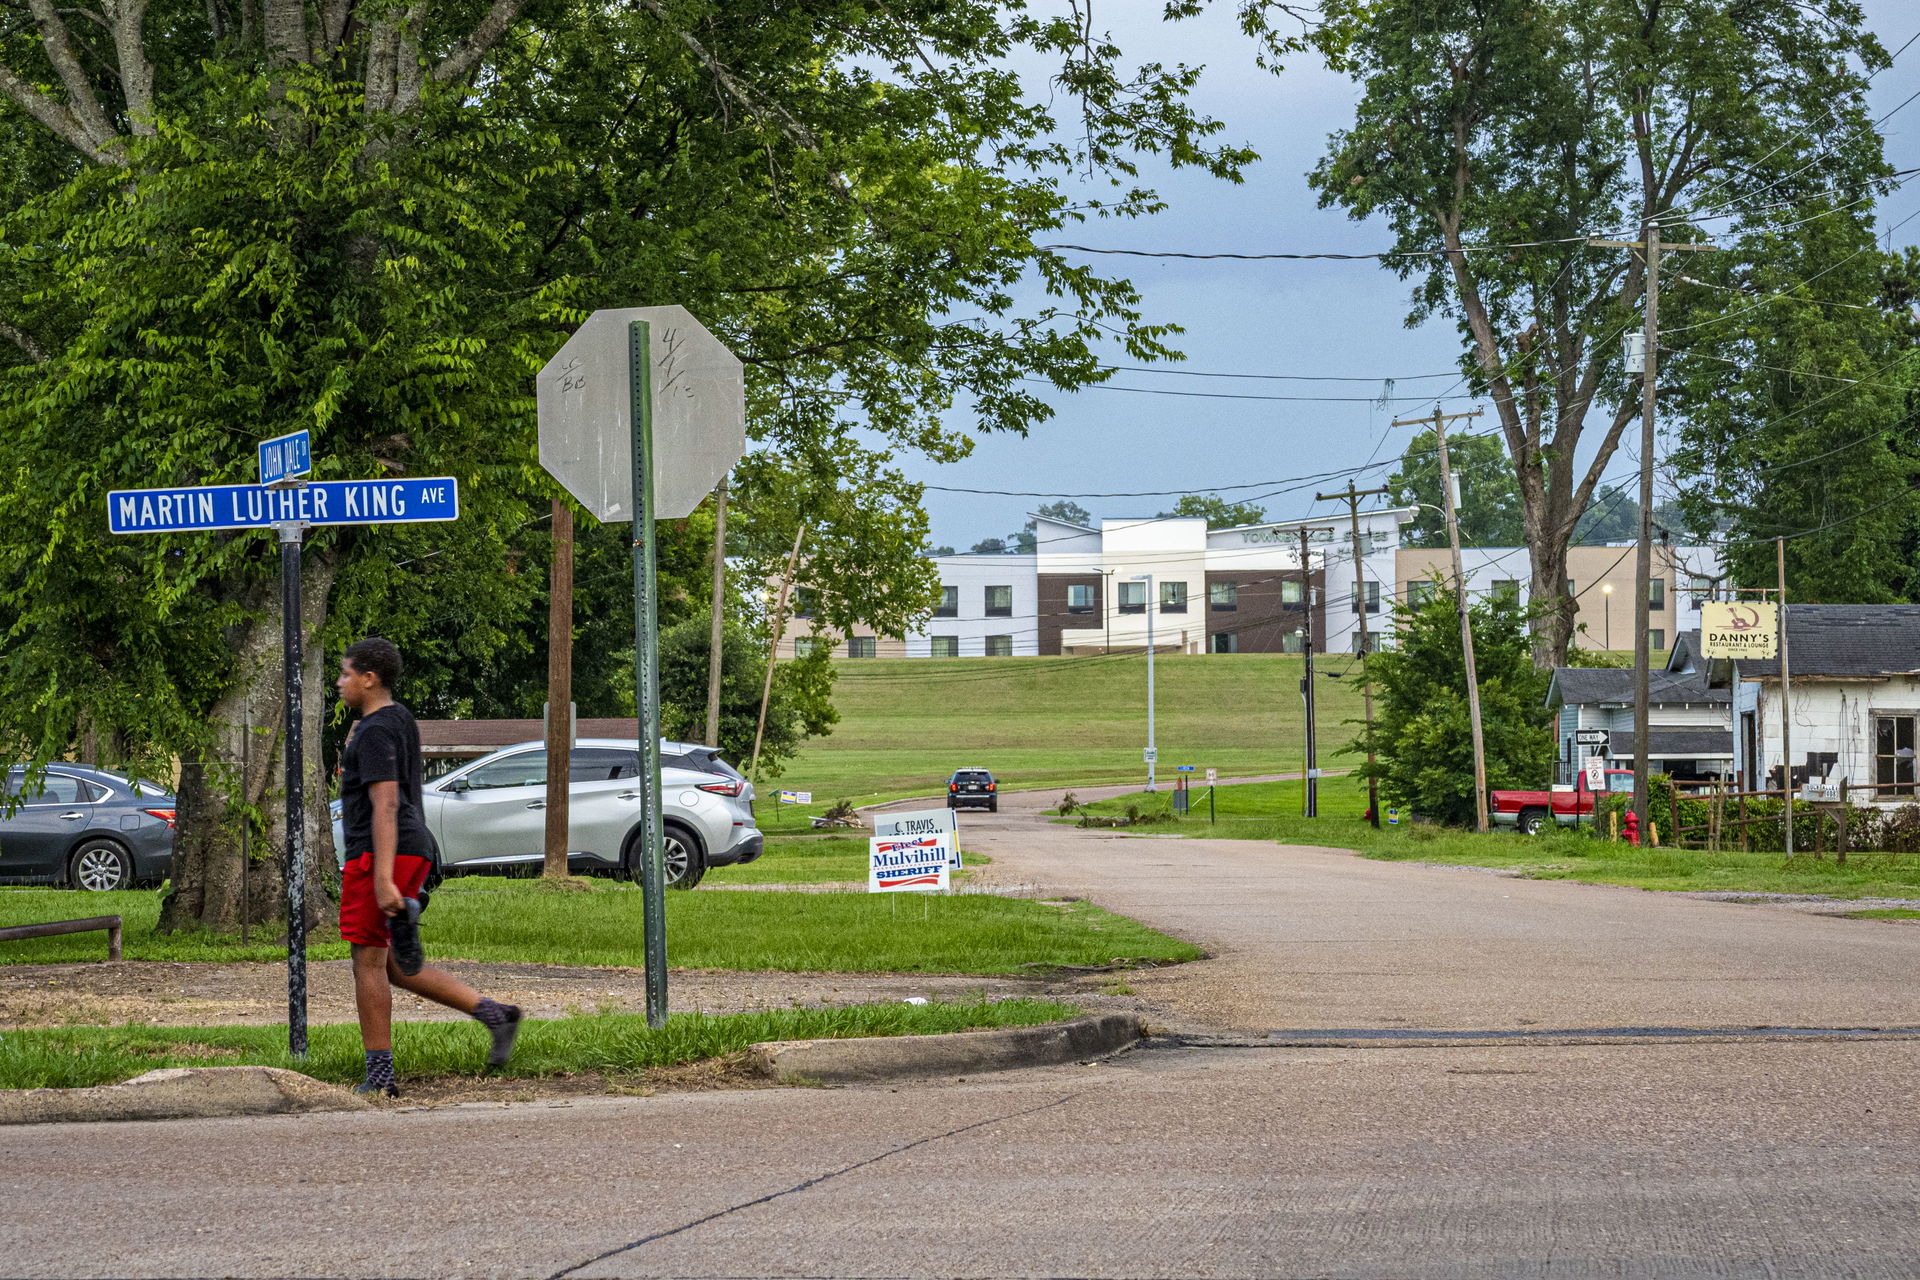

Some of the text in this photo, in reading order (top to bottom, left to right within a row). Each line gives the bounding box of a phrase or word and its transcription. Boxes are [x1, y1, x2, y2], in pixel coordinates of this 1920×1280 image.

[264, 444, 283, 479] JOHN
[284, 439, 301, 473] DALE
[119, 485, 446, 527] MARTIN LUTHER KING AVE
[1709, 633, 1769, 643] DANNY'S
[895, 821, 904, 833] C.
[905, 818, 935, 832] TRAVIS
[891, 837, 925, 852] Elect
[873, 847, 946, 867] Mulvihill
[876, 865, 943, 879] SHERIFF
